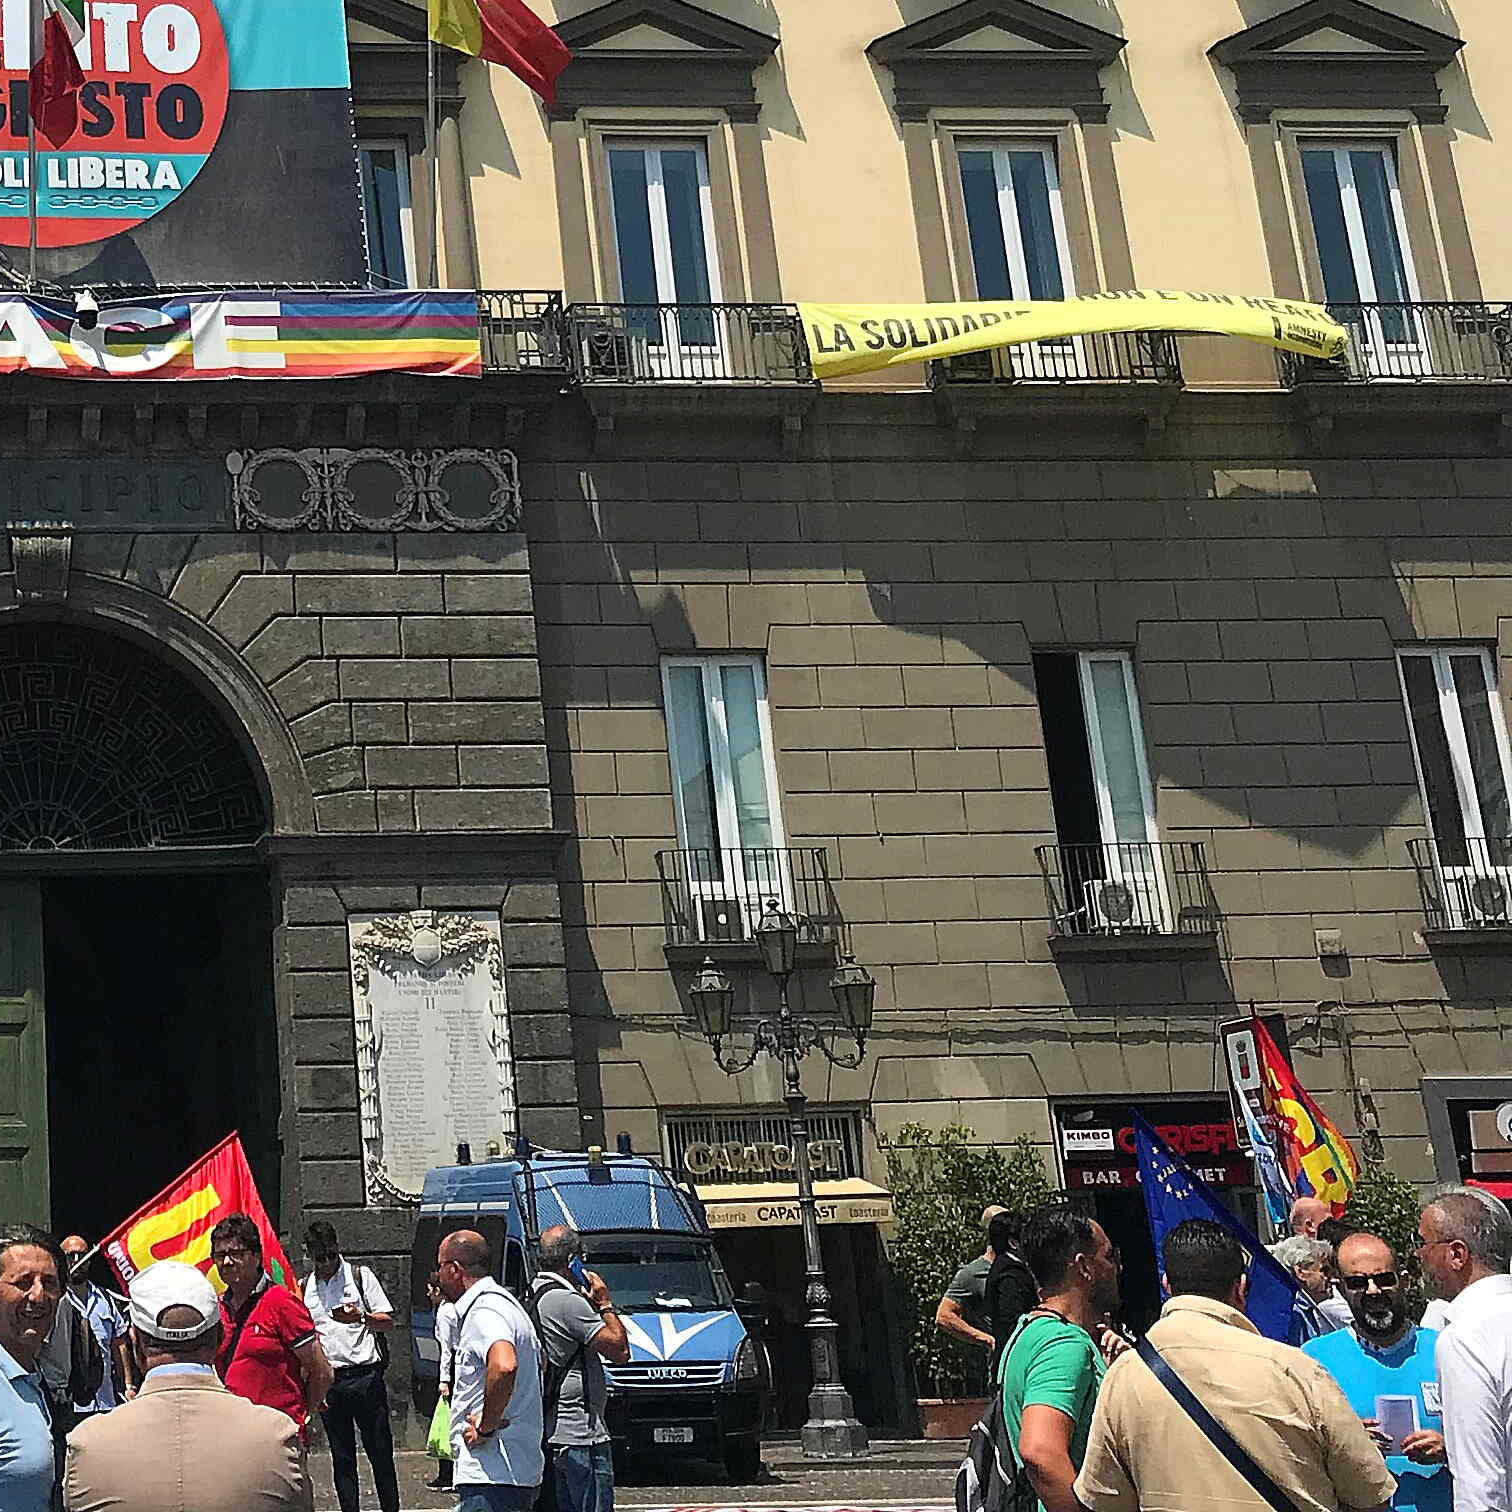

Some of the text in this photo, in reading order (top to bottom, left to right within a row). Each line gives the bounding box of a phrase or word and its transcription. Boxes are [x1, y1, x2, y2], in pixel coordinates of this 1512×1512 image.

[47, 156, 183, 190] LIBERA
[811, 323, 856, 354] LA
[1066, 1131, 1111, 1141] KIMBO
[684, 1140, 843, 1174] CAPATOST
[1082, 1171, 1122, 1185] BAR
[757, 1205, 838, 1222] CAPATAST
